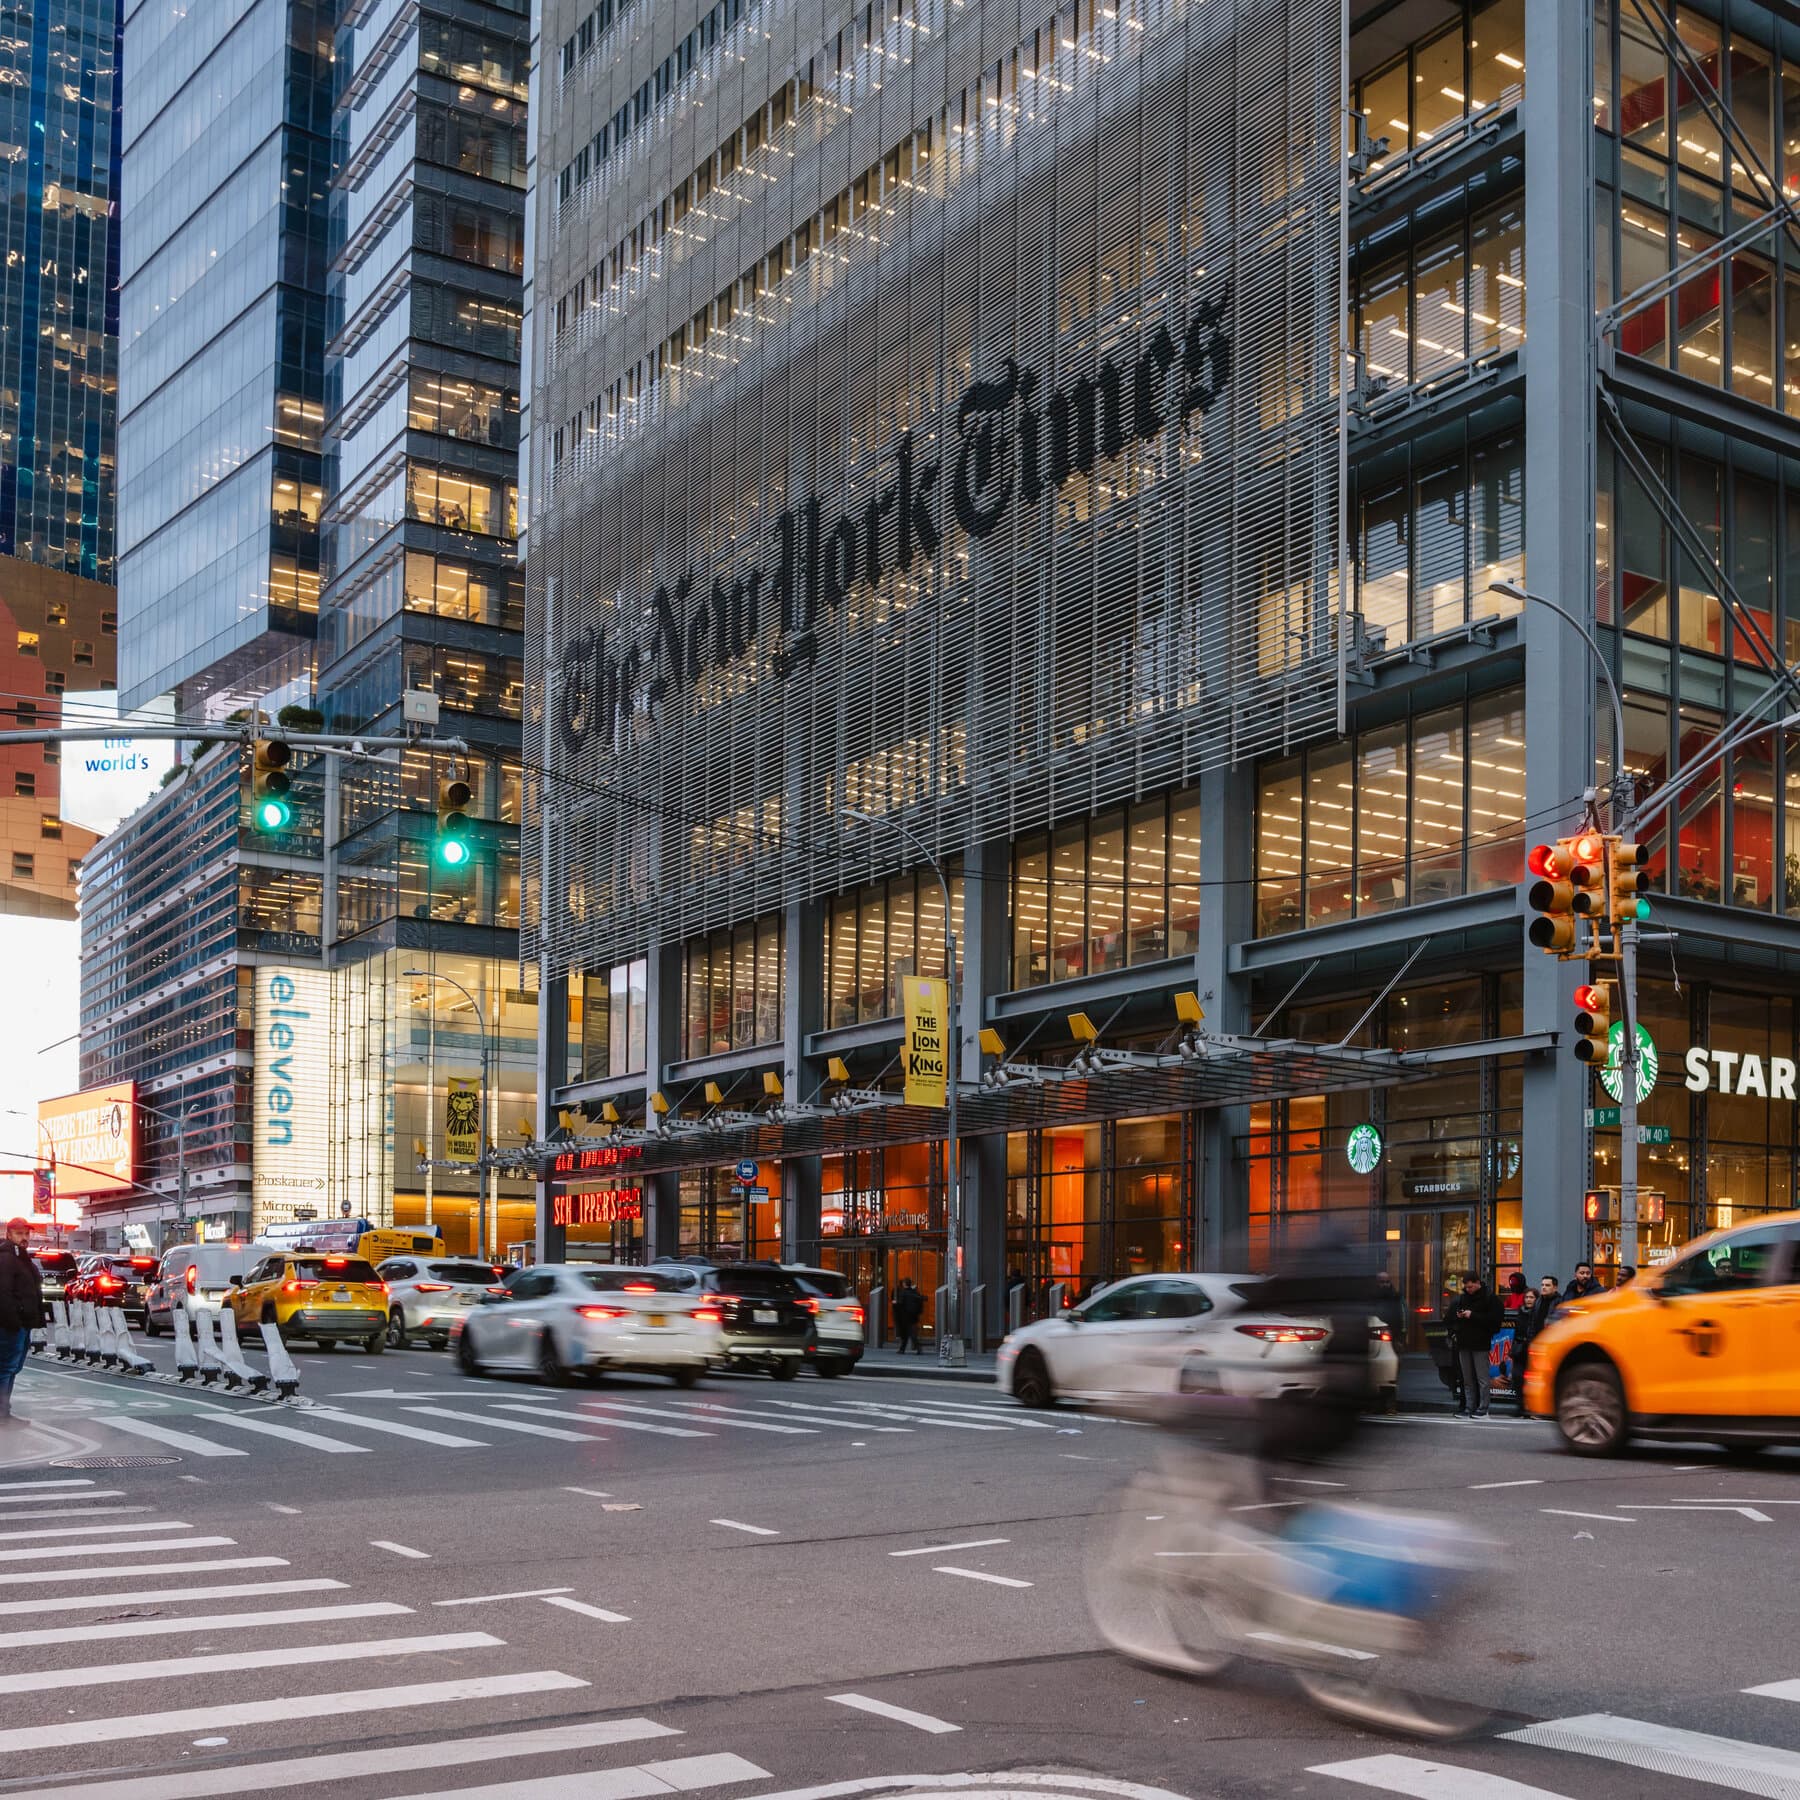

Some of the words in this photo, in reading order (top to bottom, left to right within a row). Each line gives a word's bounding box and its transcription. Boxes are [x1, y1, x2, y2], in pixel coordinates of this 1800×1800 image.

[952, 283, 1233, 540] Times
[85, 753, 149, 772] world's
[916, 1016, 937, 1028] THE
[912, 1032, 940, 1051] LION
[267, 975, 311, 1145] eleven
[909, 1053, 943, 1076] KING
[1685, 1047, 1797, 1100] STAR
[1600, 1111, 1605, 1124] 8
[1645, 1129, 1651, 1141] W
[1653, 1128, 1662, 1142] 40
[257, 1174, 314, 1188] Proskauer
[1414, 1183, 1461, 1193] STARBUCKS
[899, 1208, 927, 1226] Times
